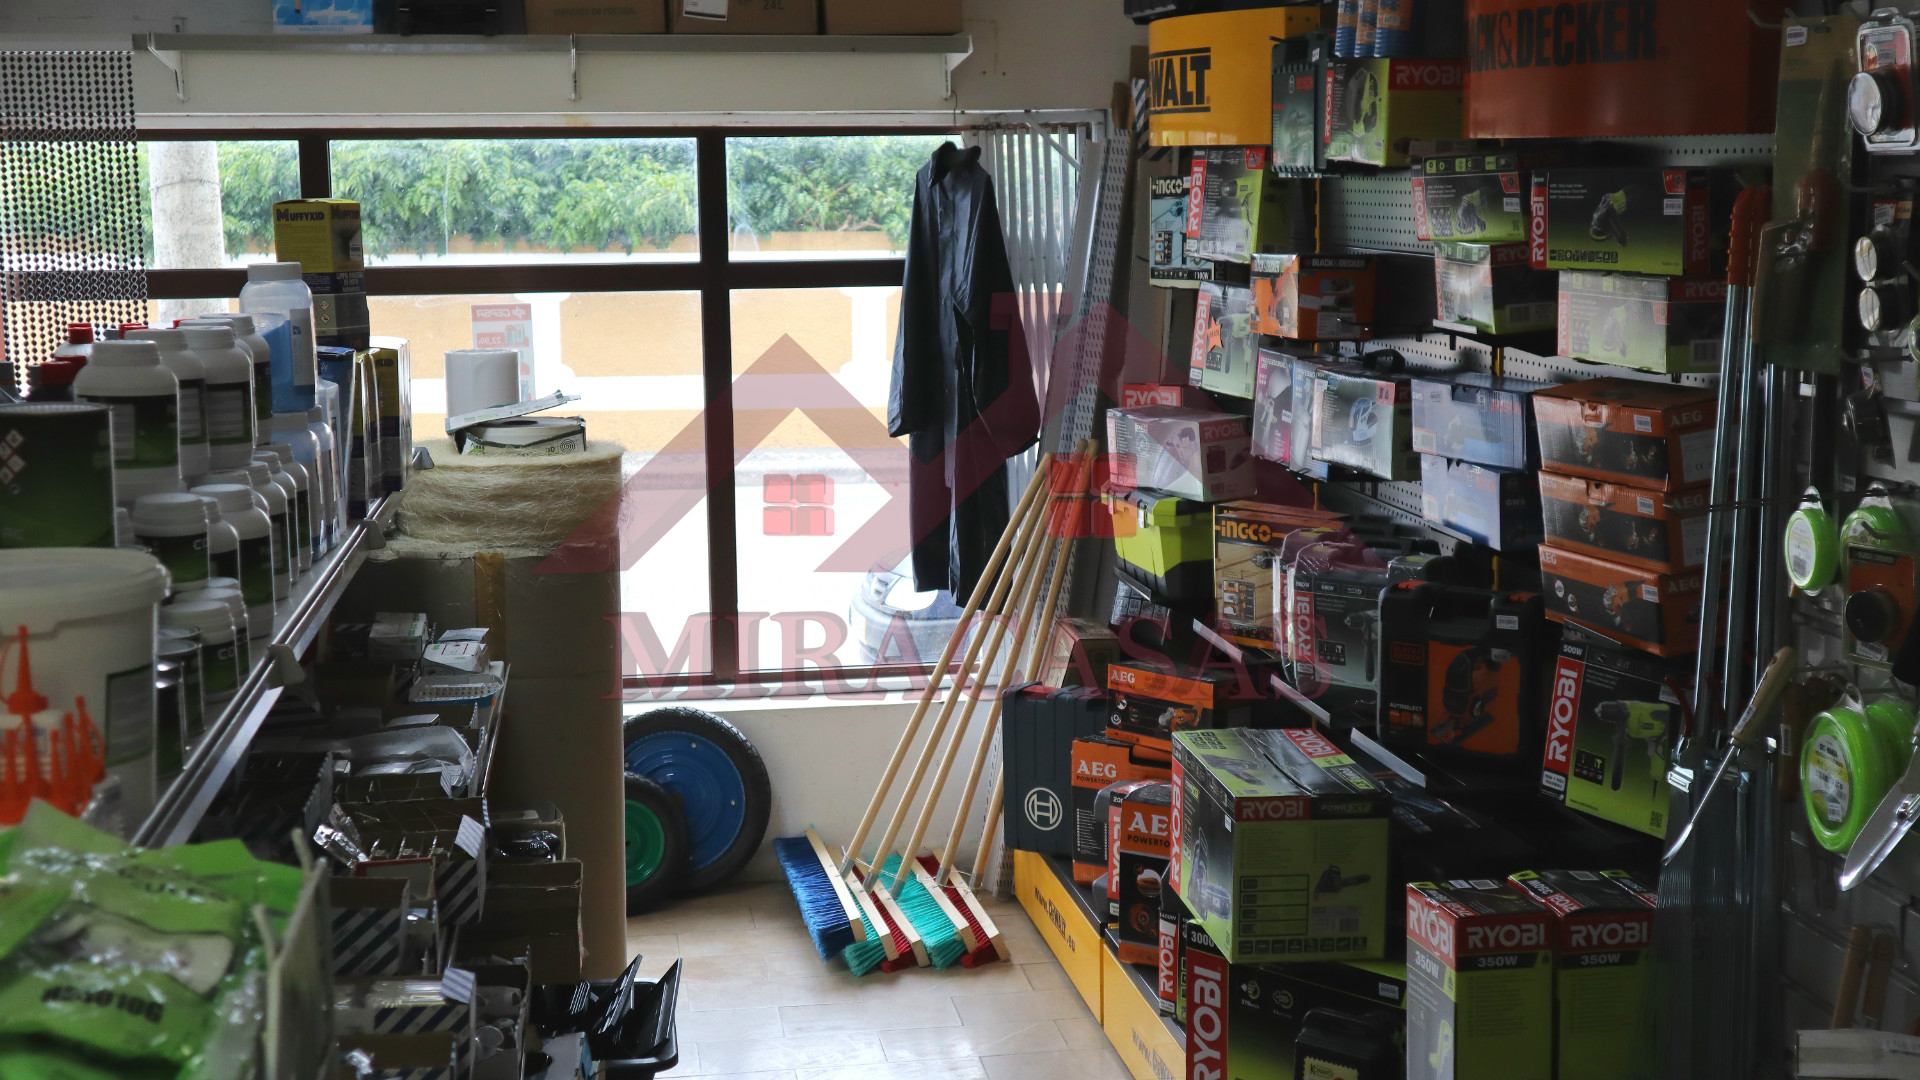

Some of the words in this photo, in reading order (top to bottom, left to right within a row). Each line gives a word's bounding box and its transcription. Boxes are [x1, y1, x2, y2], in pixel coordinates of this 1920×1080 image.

[1188, 166, 1204, 231] RYOBI
[276, 209, 325, 222] MUFFYXID
[1532, 196, 1545, 262] RYOBI
[1692, 204, 1705, 262] RYOBI
[1496, 246, 1528, 262] RYO
[1192, 299, 1208, 361] RYOBI
[1125, 390, 1177, 407] RYOBI
[1670, 410, 1703, 428] AEG
[1204, 423, 1244, 440] RYOBI
[1671, 494, 1704, 511] AEG
[1539, 551, 1557, 565] AEG
[1668, 576, 1700, 593] AEG
[1296, 596, 1312, 657] RYOBI
[1563, 644, 1583, 656] 500W
[1110, 669, 1136, 684] AEG
[1389, 702, 1423, 712] AUTOSELECT
[1547, 667, 1579, 763] RYOBI
[1288, 728, 1336, 756] RYOBI
[1076, 759, 1117, 778] AEG
[1242, 800, 1304, 819] RYOBI
[1127, 811, 1169, 836] AE
[1171, 773, 1182, 884] RYOBI
[1127, 834, 1171, 848] POWERTO
[1408, 900, 1454, 958] RYOBI
[1467, 922, 1546, 948] RYOBI
[1570, 921, 1649, 947] RYOBI
[1160, 921, 1177, 994] RYOBI
[1414, 951, 1440, 979] 350W
[1477, 955, 1518, 968] 350W
[1580, 953, 1620, 966] 350W
[1193, 965, 1222, 1080] RYOBI
